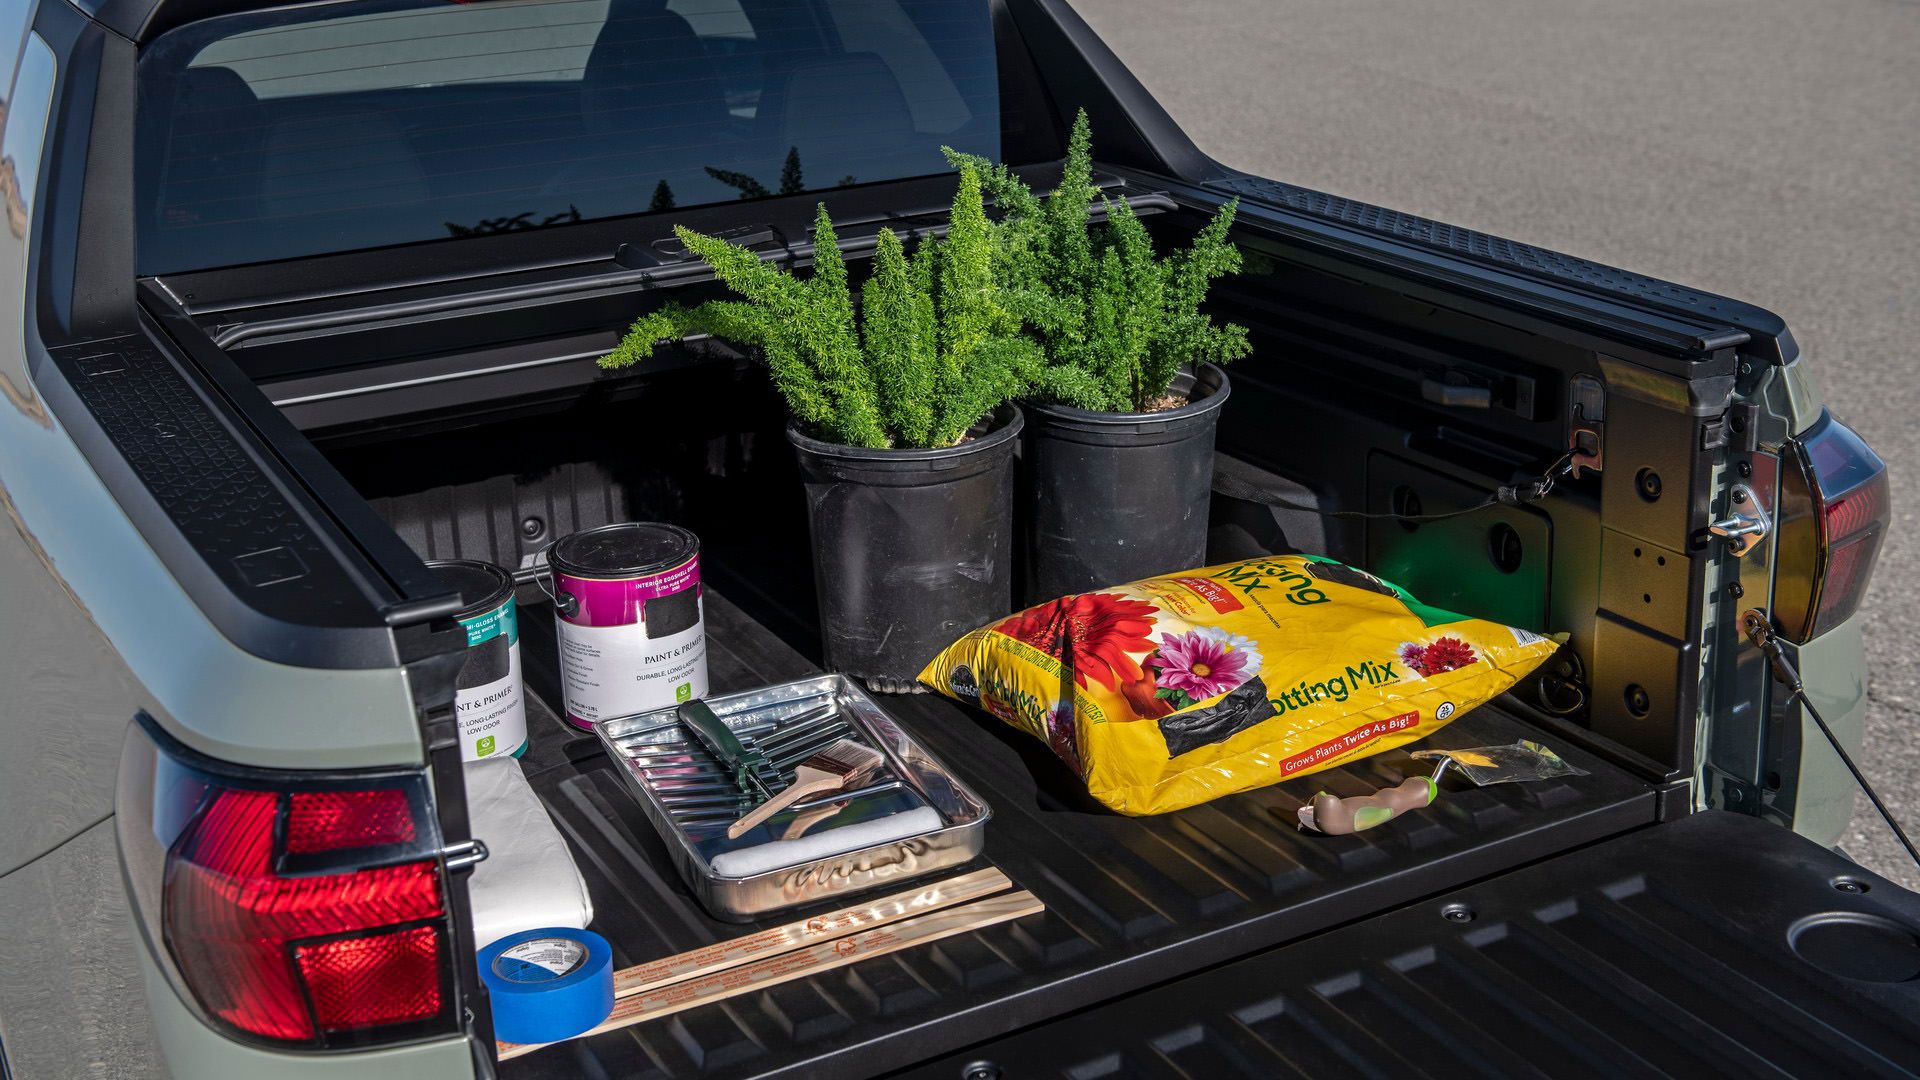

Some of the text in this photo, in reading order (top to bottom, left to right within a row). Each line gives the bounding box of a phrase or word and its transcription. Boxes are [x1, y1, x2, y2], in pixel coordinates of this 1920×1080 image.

[636, 578, 662, 590] INTERIOR
[664, 570, 687, 584] EGGSHELL
[1195, 584, 1207, 592] As
[466, 617, 494, 630] MI-GLOSS
[644, 650, 672, 664] PAINT
[674, 648, 680, 657] &
[636, 671, 666, 681] DURABLE,
[668, 668, 695, 684] LOW ODOR
[1269, 660, 1399, 716] otting Mix
[474, 700, 481, 708] &
[484, 686, 513, 706] PRIMER
[466, 707, 507, 727] LONG-LASTING
[466, 720, 501, 736] LOW ODOR
[1285, 754, 1314, 772] Grows
[1316, 742, 1343, 759] Plants
[1343, 728, 1370, 747] Twice
[1372, 722, 1387, 734] As
